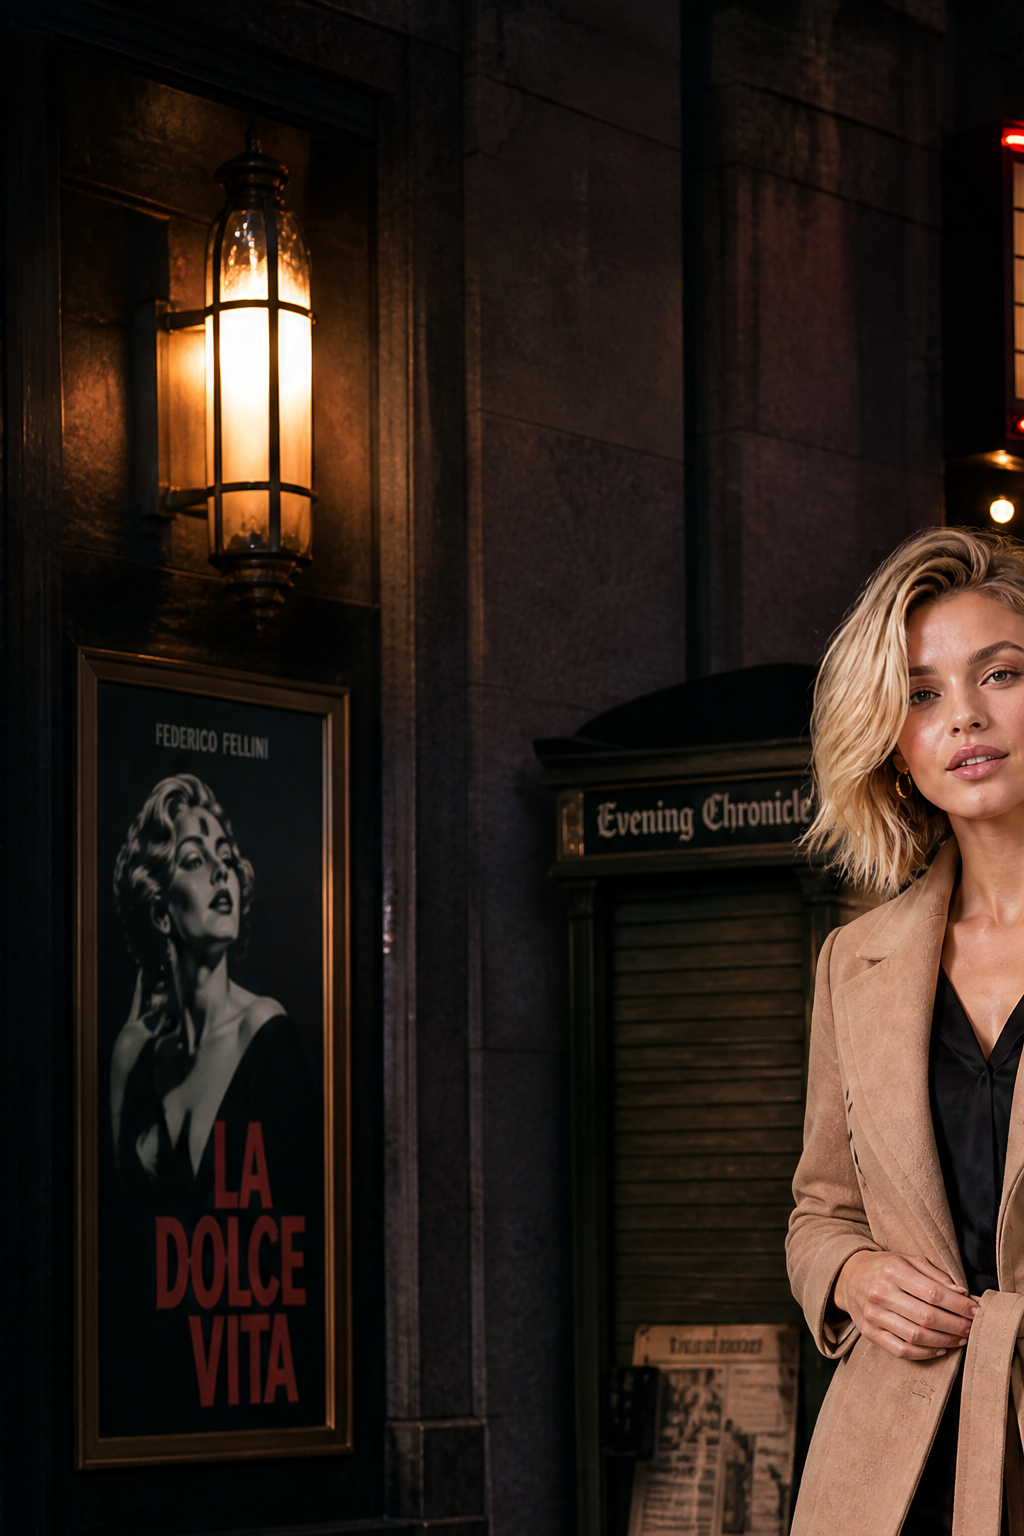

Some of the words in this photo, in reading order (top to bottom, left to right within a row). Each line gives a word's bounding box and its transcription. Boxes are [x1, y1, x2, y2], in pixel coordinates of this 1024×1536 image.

[155, 722, 219, 754] FEDERICO
[222, 731, 269, 760] FELLINI
[596, 800, 695, 842] Evening
[702, 788, 812, 833] Chronicle
[213, 1121, 274, 1209] LA
[155, 1214, 307, 1310] DOLCE
[188, 1313, 300, 1407] VITA
